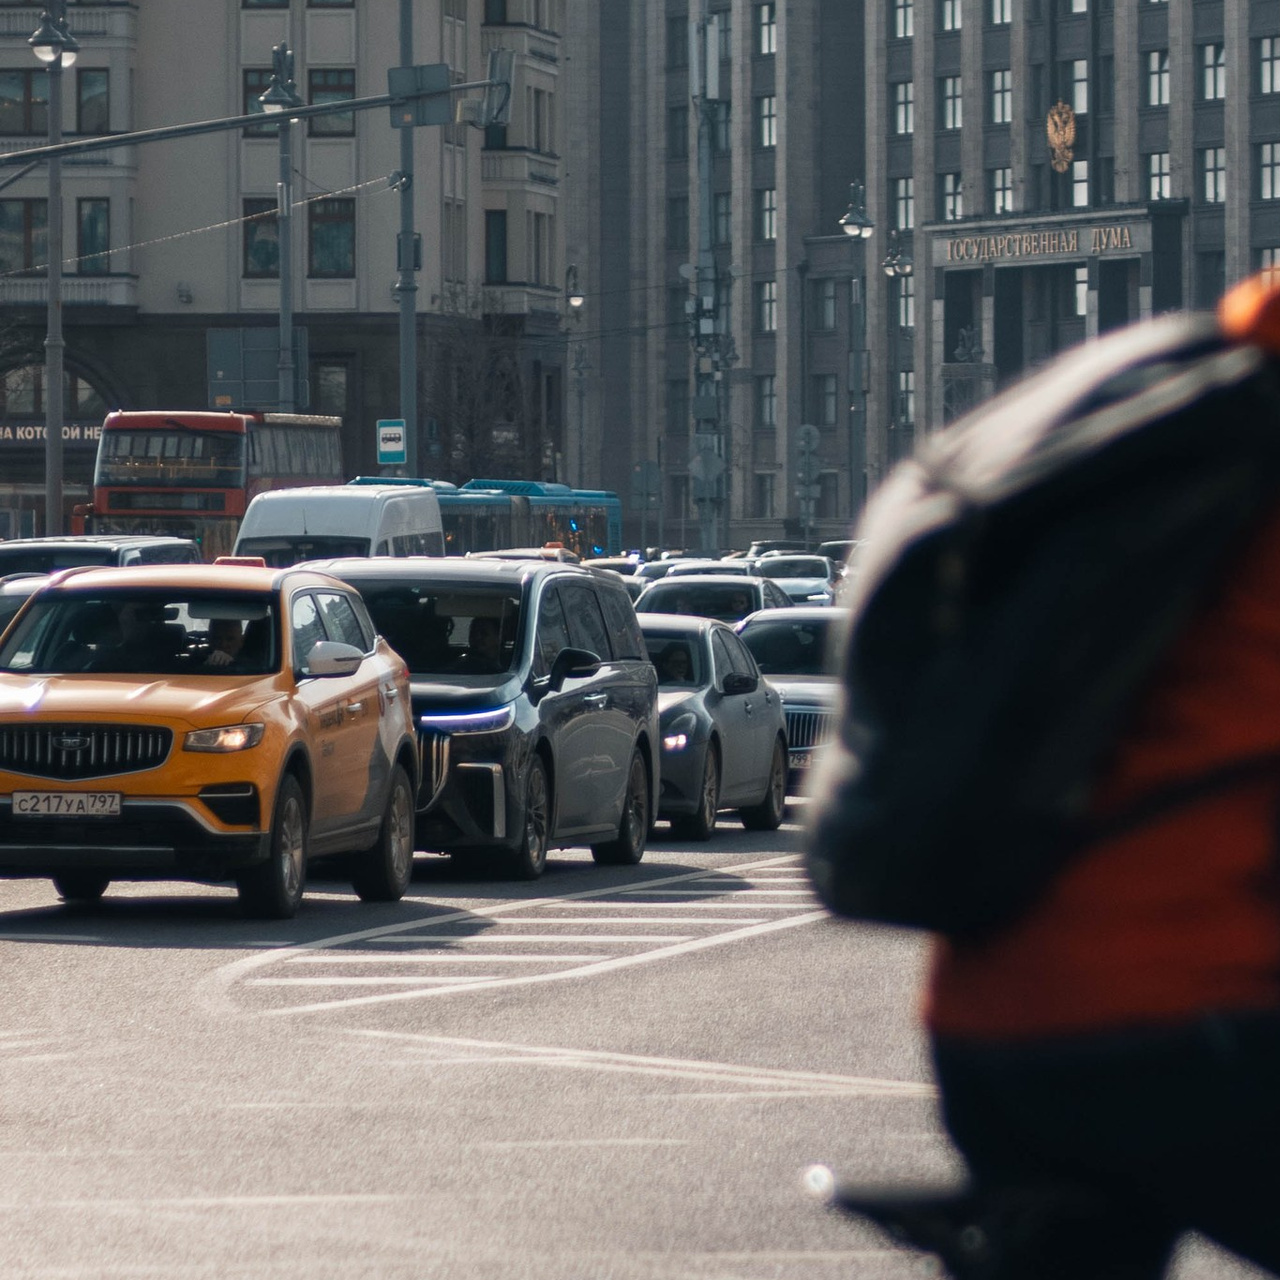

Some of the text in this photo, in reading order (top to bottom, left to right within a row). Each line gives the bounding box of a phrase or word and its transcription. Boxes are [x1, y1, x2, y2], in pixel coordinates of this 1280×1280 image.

[947, 226, 1131, 261] ГОСУДАРСТВЕННАЯ ДУМА
[16, 424, 80, 439] КОТОЙ
[18, 794, 116, 813] С217УА 797
